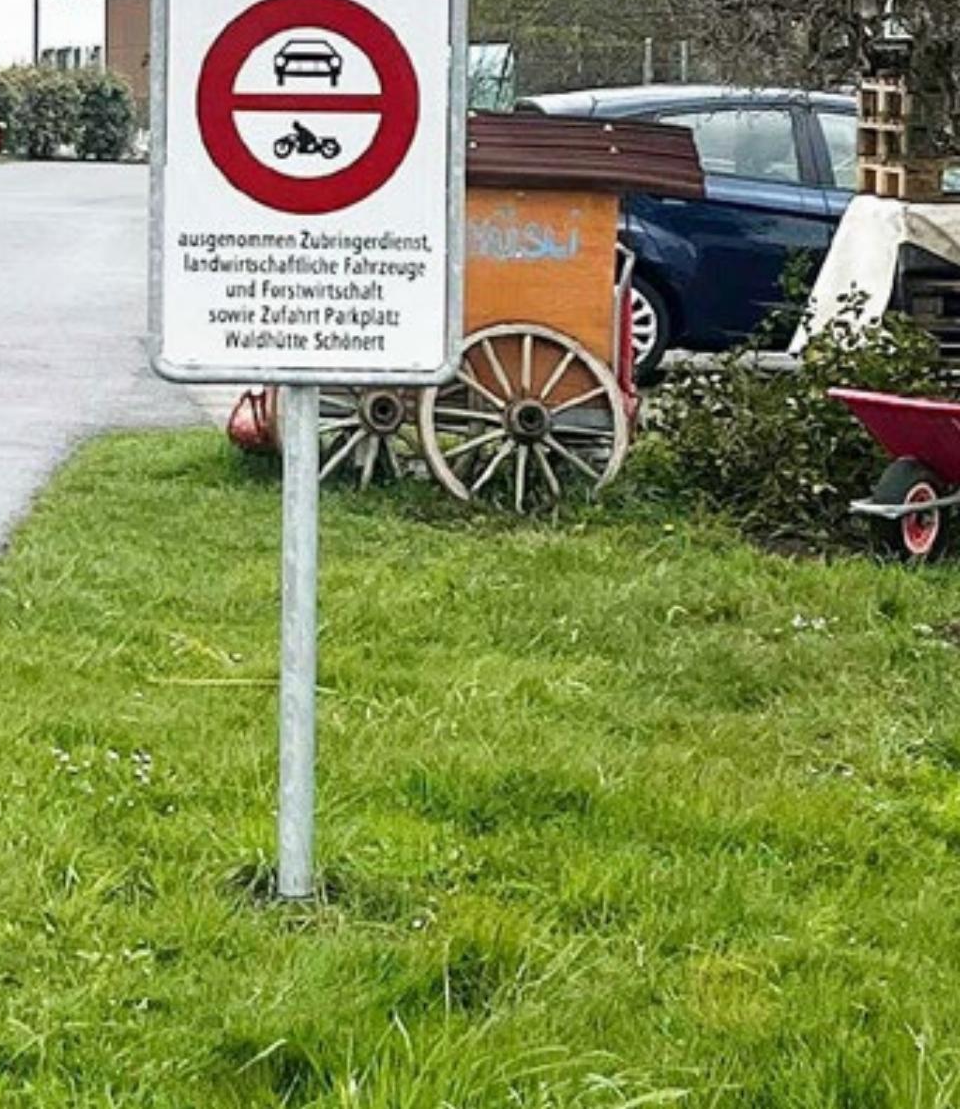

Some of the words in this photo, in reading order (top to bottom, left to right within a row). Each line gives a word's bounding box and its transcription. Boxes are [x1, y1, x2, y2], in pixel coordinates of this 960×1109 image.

[178, 233, 296, 252] ausgenommen
[300, 230, 432, 254] Zubringerdienst,
[184, 254, 339, 275] landwirtschaftliche
[344, 257, 426, 280] Fahrzeuge
[226, 280, 255, 298] und
[262, 280, 382, 300] Forstwirtschaft
[209, 306, 255, 323] sowie
[260, 305, 320, 325] Zufahrt
[325, 307, 399, 330] Parkplatz
[226, 331, 308, 350] Waldhütte
[314, 331, 384, 351] Schönert
